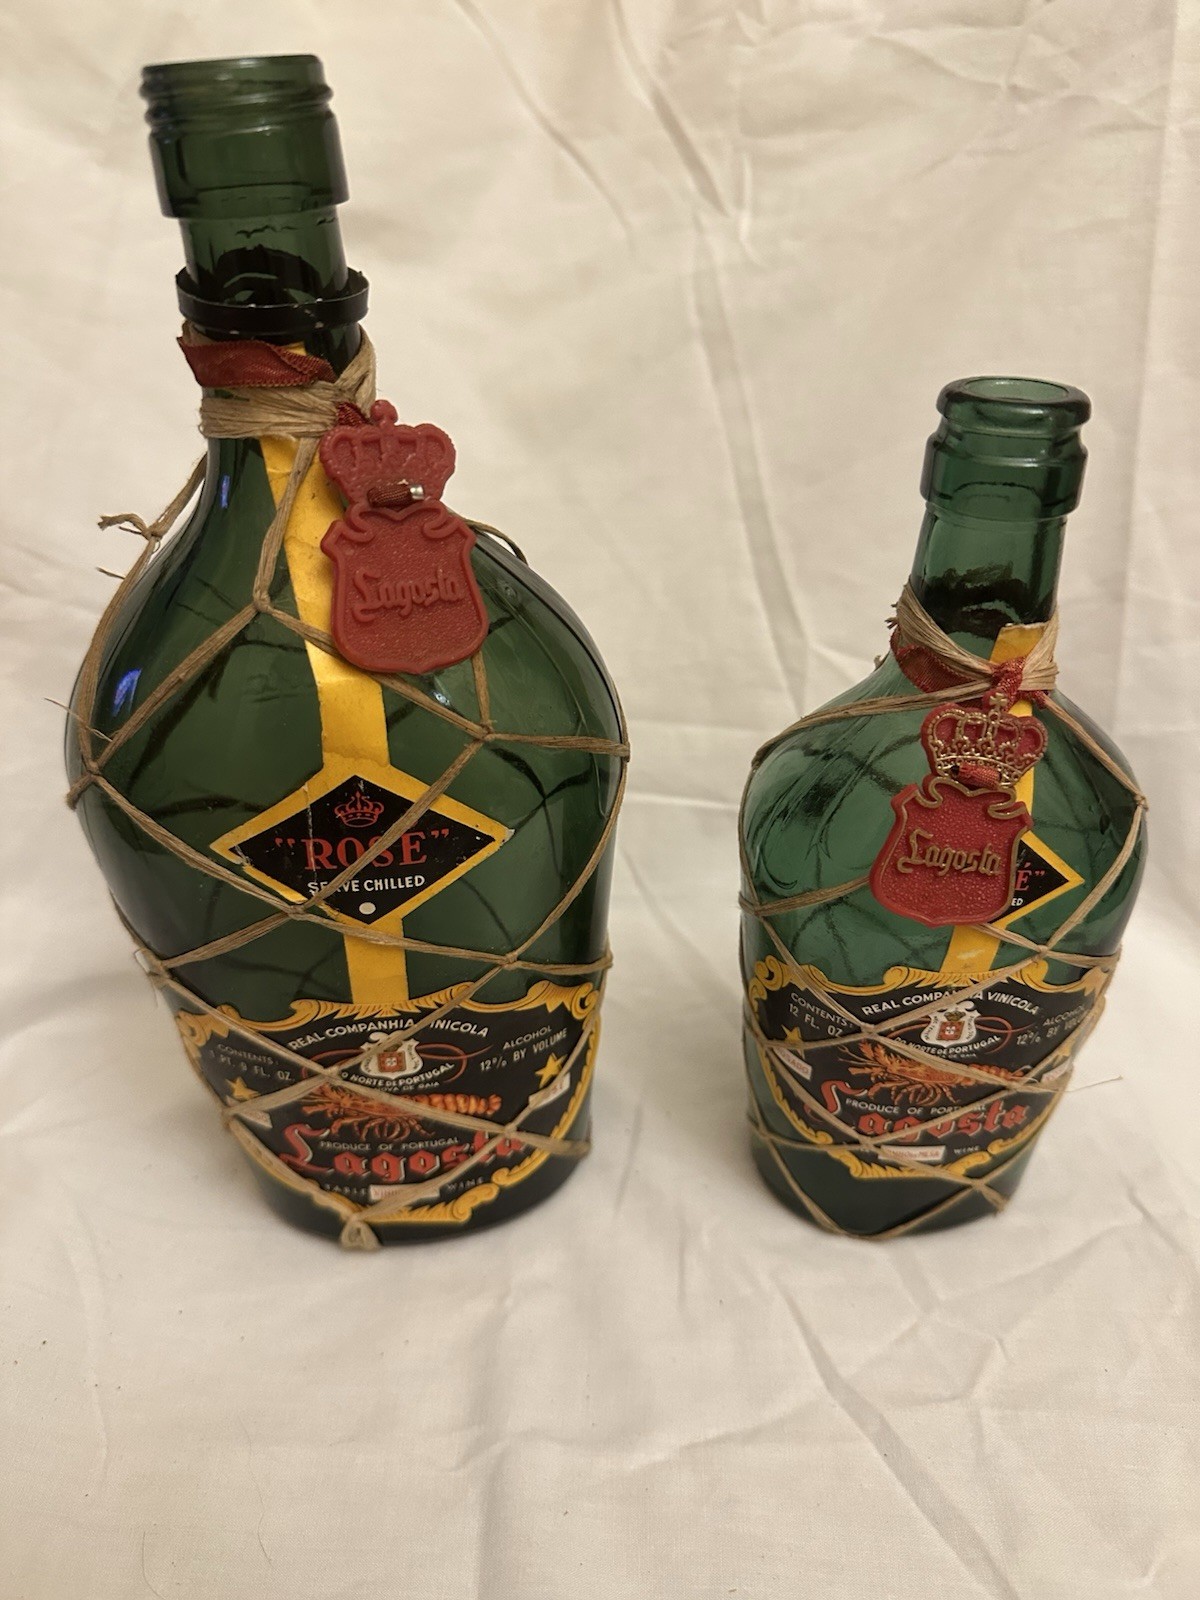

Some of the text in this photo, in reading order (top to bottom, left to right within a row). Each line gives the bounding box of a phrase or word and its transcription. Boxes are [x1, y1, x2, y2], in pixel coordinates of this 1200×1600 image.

[353, 566, 464, 623] Lagosta
[897, 828, 1001, 876] Lagosta
[307, 874, 425, 897] SEVE CHILLED
[788, 1003, 799, 1017] 12
[804, 1013, 820, 1029] FL.
[862, 1000, 900, 1016] REAL
[987, 991, 1040, 1015] VINICOLA
[288, 1019, 489, 1050] REAL COMPANHIA INICOLA
[502, 1025, 553, 1050] ALCOHOL
[1046, 1024, 1060, 1038] BY
[480, 1027, 568, 1073] 12% BY VOLUME
[949, 1035, 1001, 1055] PORTUGAL
[350, 1074, 385, 1087] NORTE
[397, 1062, 456, 1087] PORTUGAL
[803, 1079, 1031, 1144] Lagosta
[845, 1097, 900, 1114] PRODUCE
[907, 1106, 923, 1115] OF
[279, 1123, 527, 1184] Lagosta
[319, 1136, 458, 1151] PRODUCE OF PORTUGAL
[446, 1176, 484, 1191] WINE
